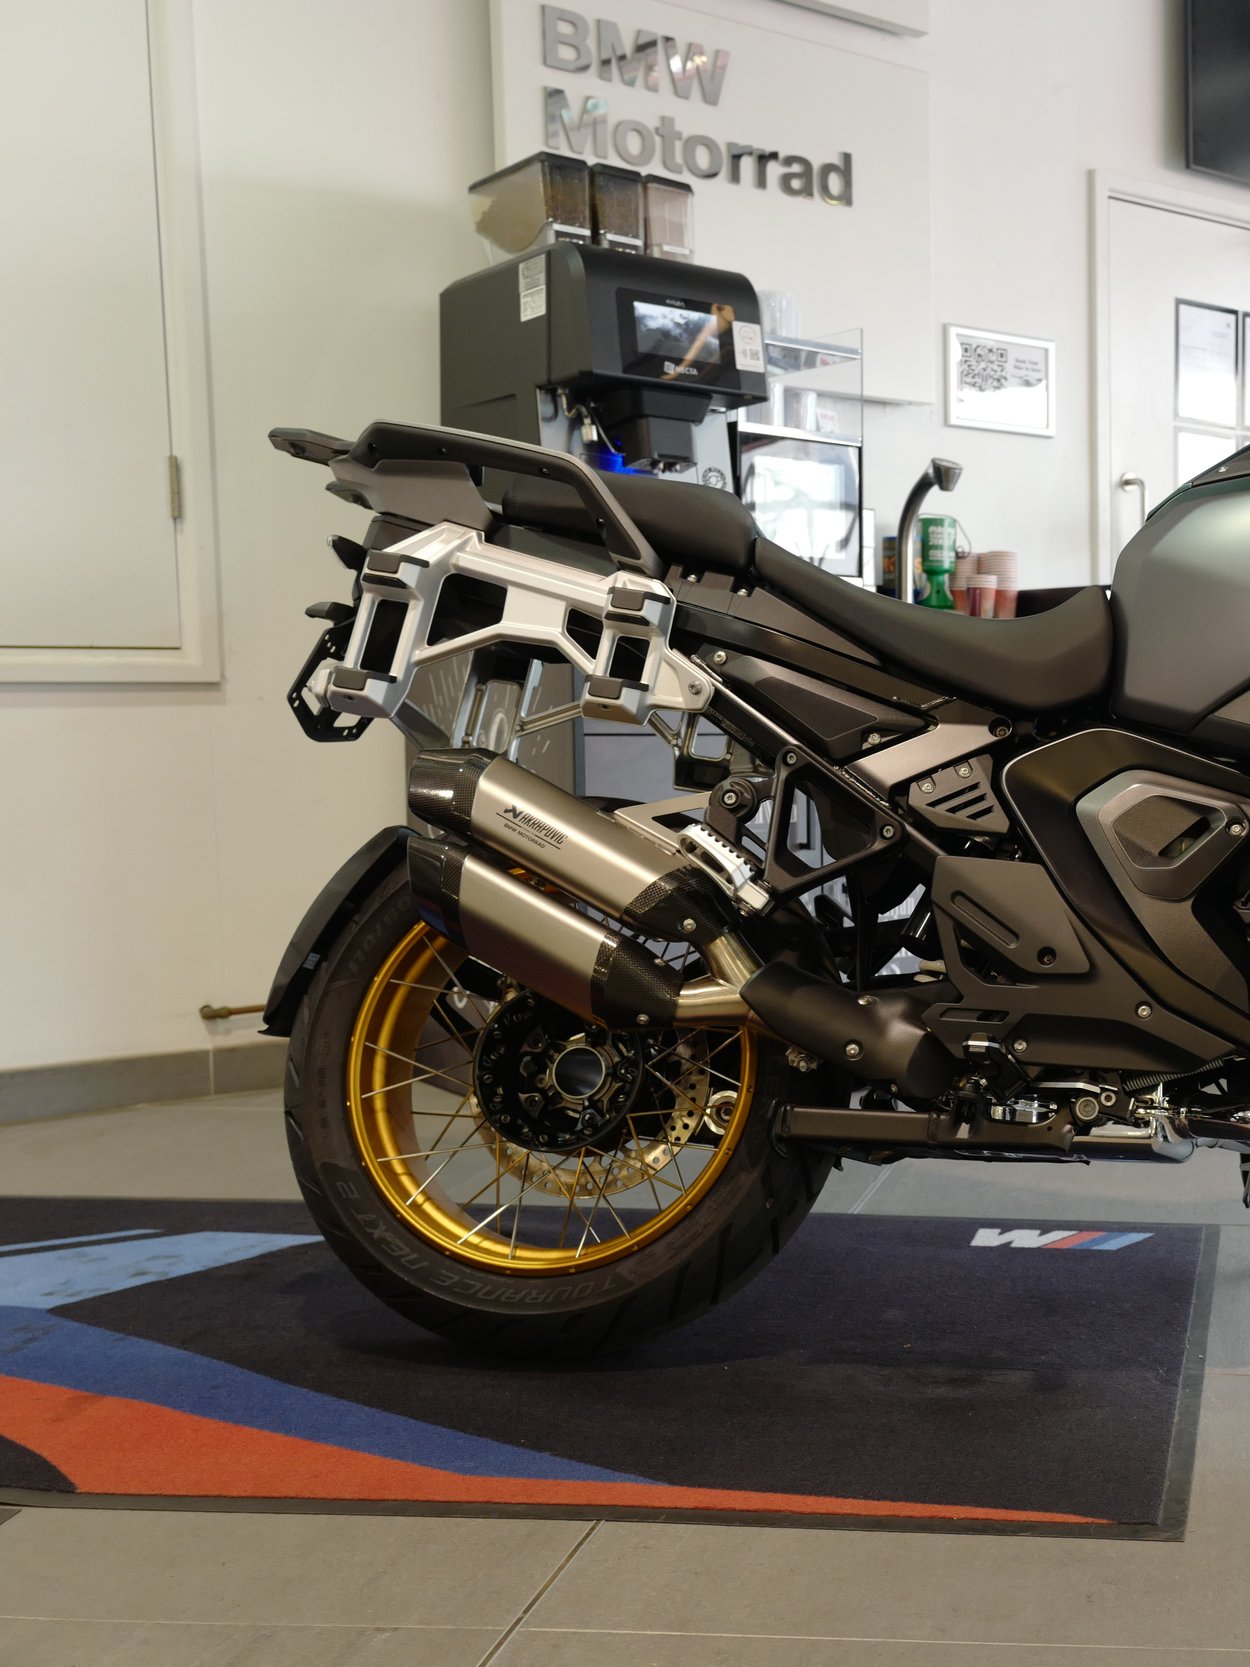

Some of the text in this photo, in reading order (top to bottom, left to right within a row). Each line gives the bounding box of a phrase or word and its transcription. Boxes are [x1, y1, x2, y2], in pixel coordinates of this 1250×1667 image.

[542, 4, 731, 106] BMW
[543, 86, 853, 207] Motorrad
[504, 823, 545, 848] BMW MOTORRAD
[351, 1207, 429, 1270] NEXT
[430, 1269, 616, 1303] TOURANCE
